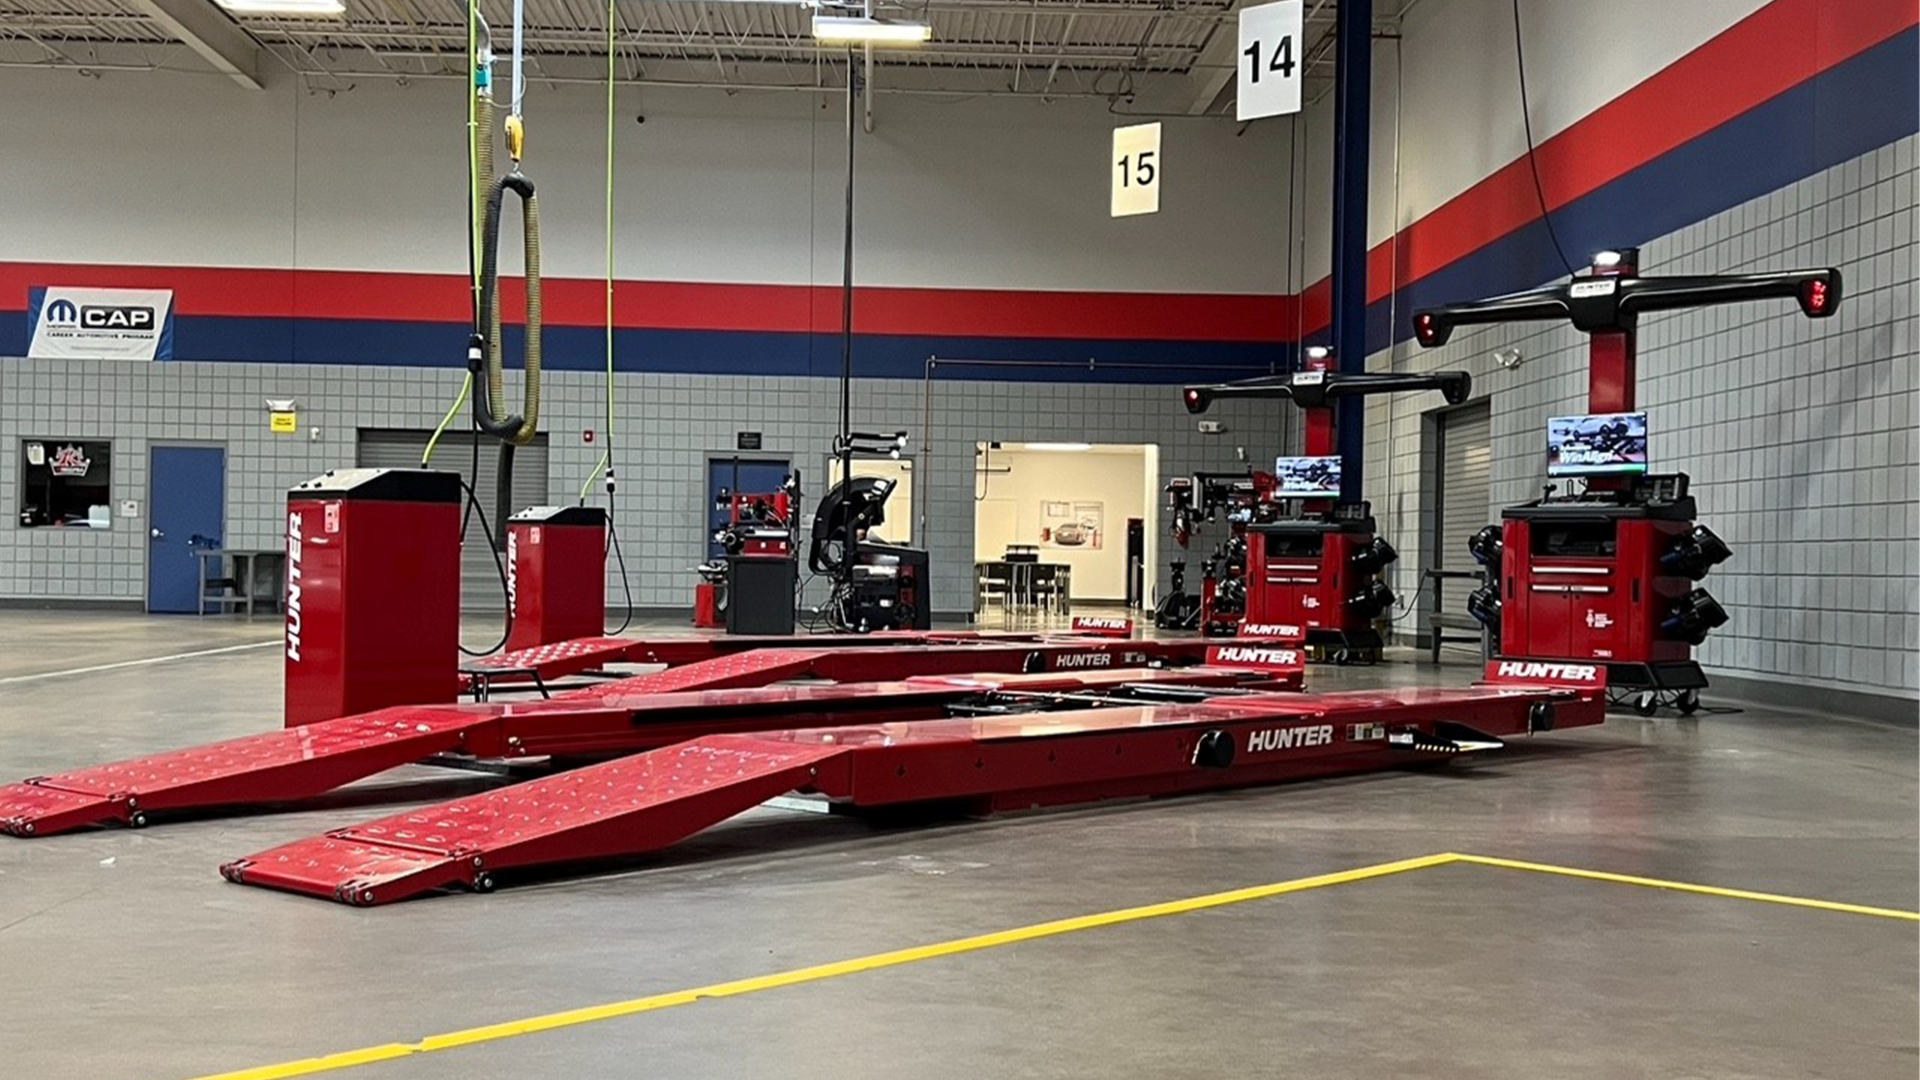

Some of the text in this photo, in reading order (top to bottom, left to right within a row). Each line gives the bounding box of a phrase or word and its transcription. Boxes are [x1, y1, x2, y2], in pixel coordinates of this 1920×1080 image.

[1243, 35, 1296, 84] 14
[1117, 151, 1155, 188] 15
[85, 310, 150, 326] CAP
[287, 512, 302, 662] HUNTER
[1077, 617, 1127, 629] HUNTER
[1244, 624, 1299, 636] HUNTER
[1056, 653, 1111, 667] HUNTER
[1216, 647, 1297, 664] HUNTER
[1498, 662, 1596, 680] HUNTER
[1247, 724, 1333, 752] HUNTER
